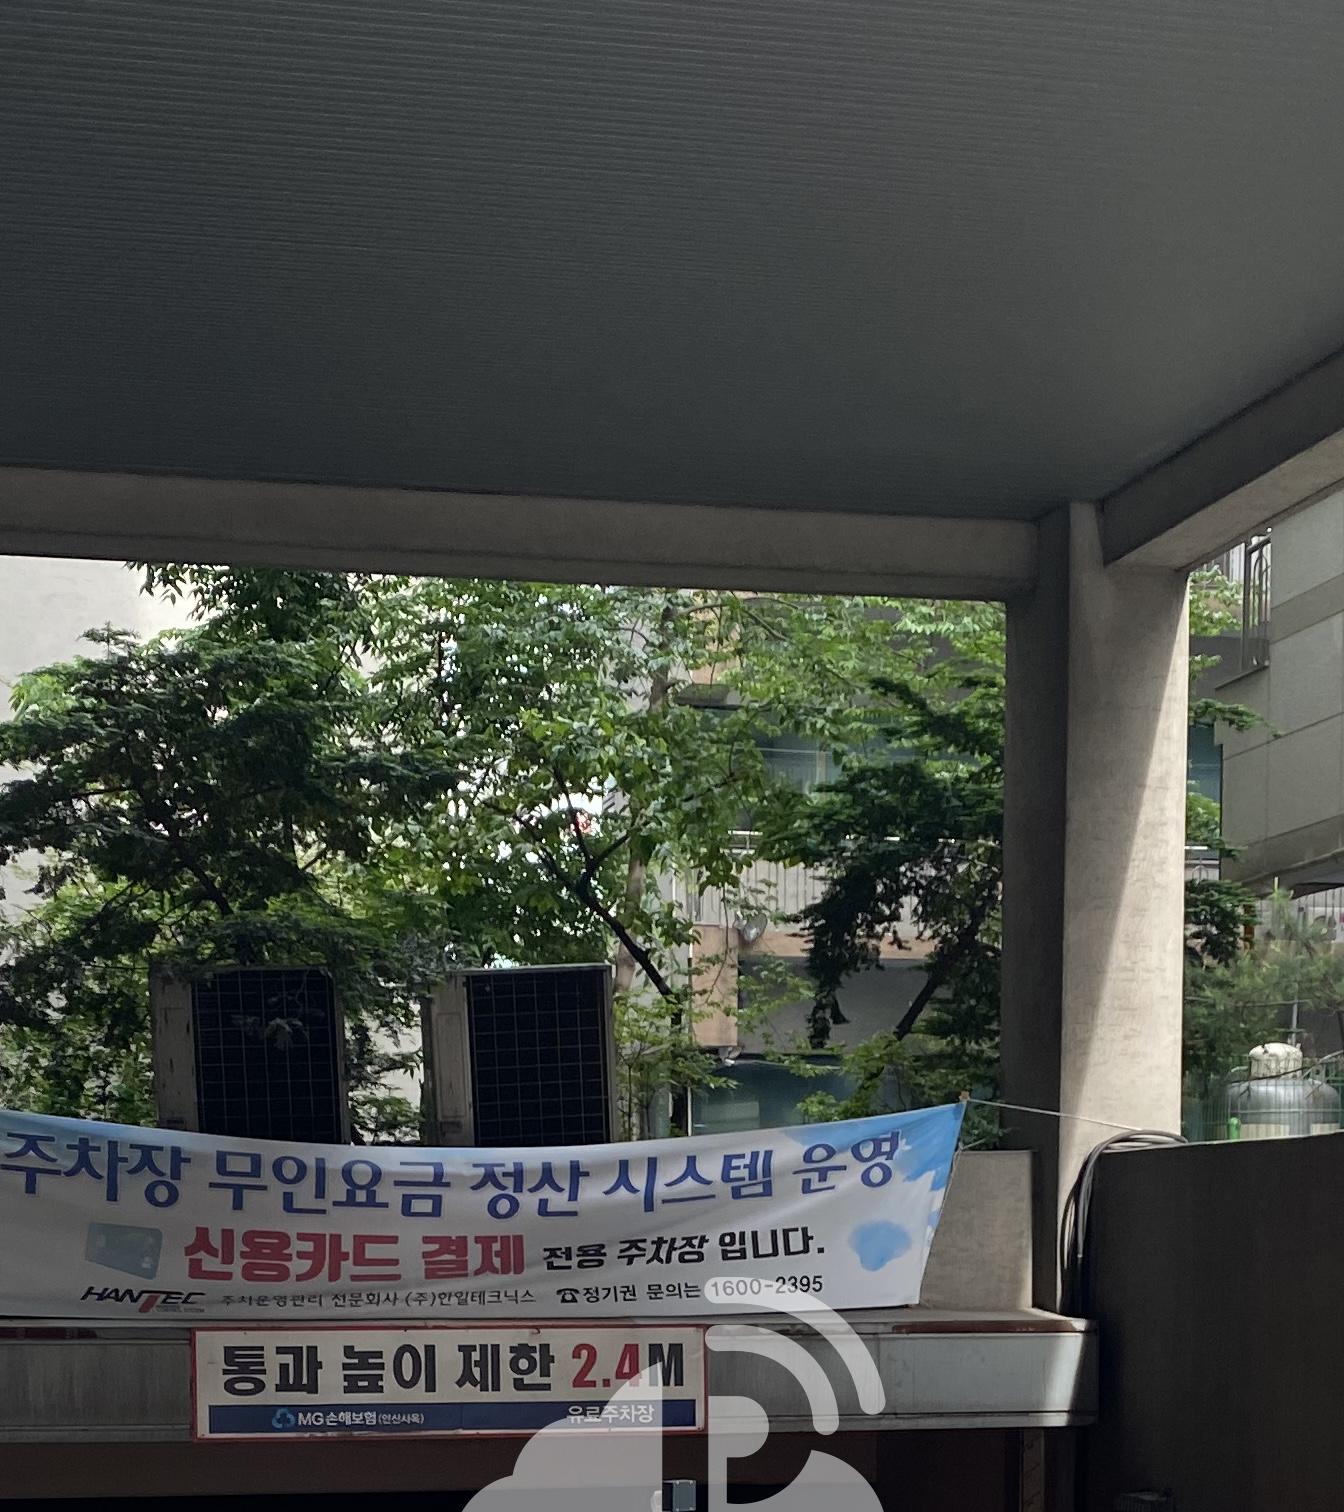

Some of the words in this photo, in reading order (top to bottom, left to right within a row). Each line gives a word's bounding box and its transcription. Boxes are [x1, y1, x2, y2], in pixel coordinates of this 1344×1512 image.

[0, 1131, 190, 1208] 주차장
[209, 1149, 451, 1218] 무인요금
[471, 1160, 589, 1219] 정산
[603, 1150, 773, 1213] 시스템
[792, 1129, 901, 1195] 운영
[185, 1227, 399, 1283] 신용카드
[422, 1234, 525, 1279] 결제
[543, 1243, 606, 1271] 전용
[617, 1235, 709, 1266] 주차장
[718, 1226, 825, 1259] 입니다.
[80, 1286, 206, 1313] HANTEC
[332, 1292, 399, 1308] 전문회사
[582, 1284, 637, 1304] 정기권
[646, 1281, 702, 1301] 문의는
[711, 1275, 823, 1298] 1600-2395
[222, 1345, 323, 1396] 통과
[342, 1344, 436, 1394] 높이
[455, 1343, 555, 1392] 제한
[572, 1343, 684, 1388] 2.4M
[568, 1404, 655, 1424] 유료주차장
